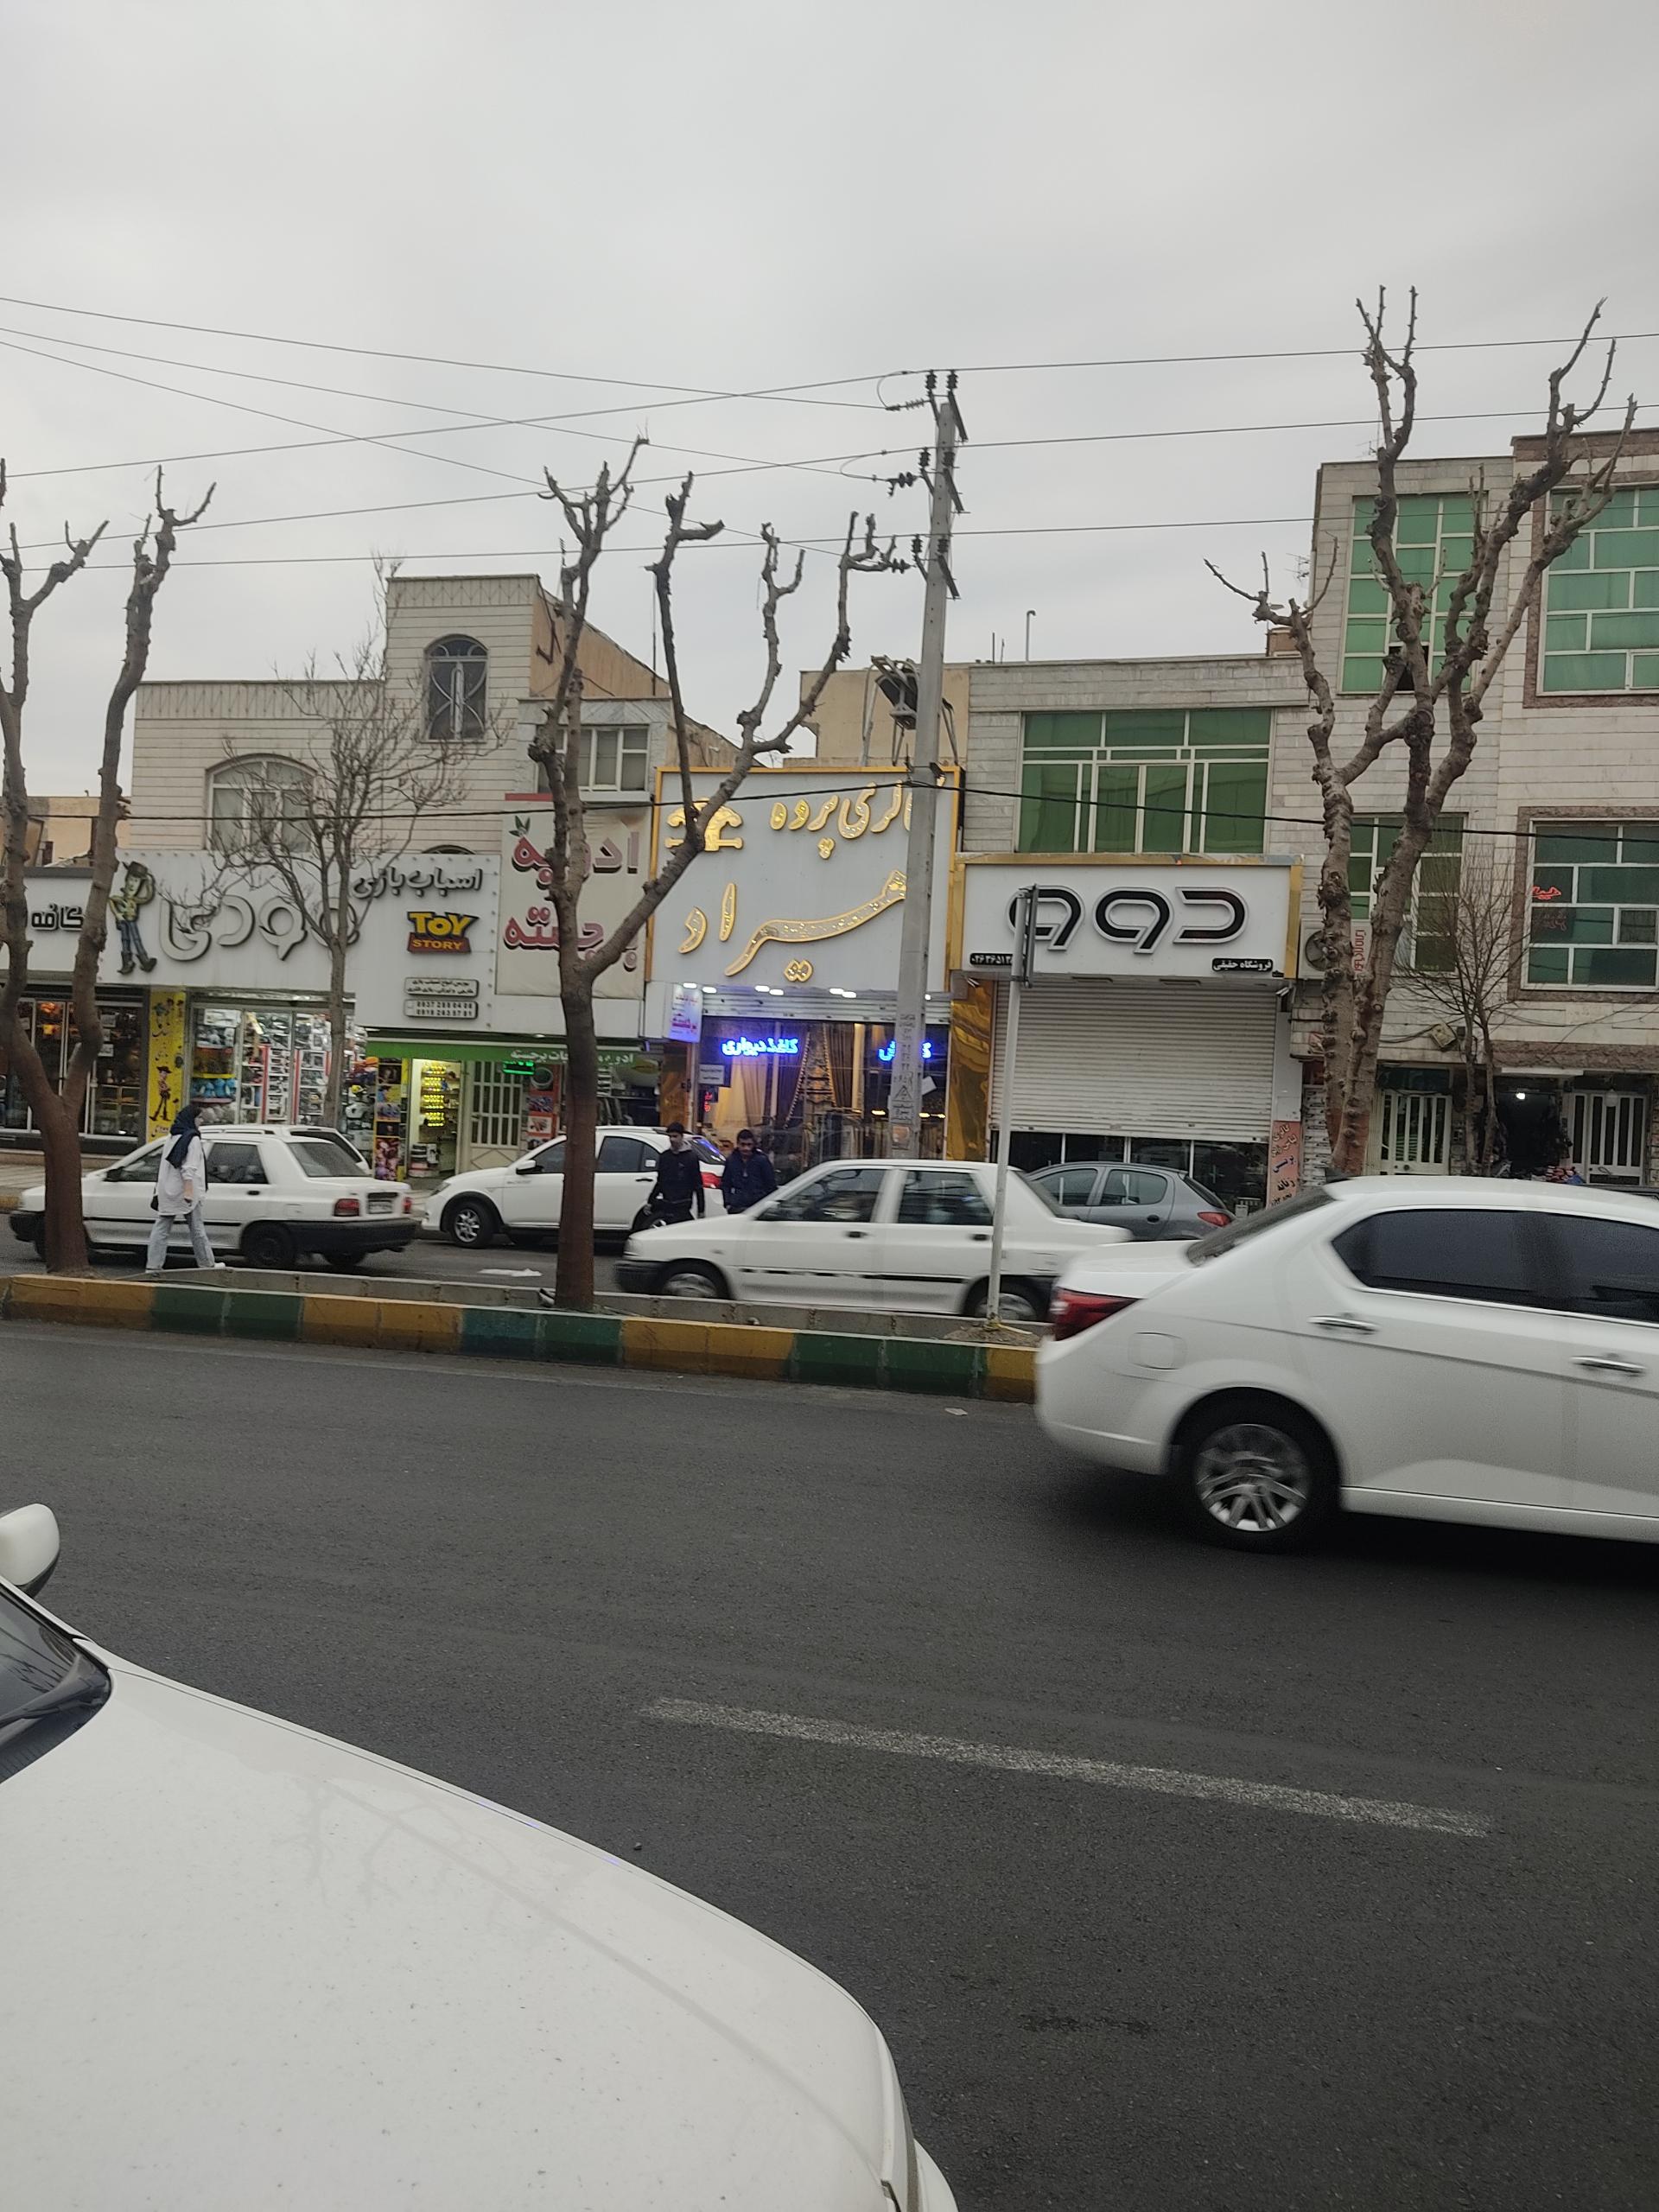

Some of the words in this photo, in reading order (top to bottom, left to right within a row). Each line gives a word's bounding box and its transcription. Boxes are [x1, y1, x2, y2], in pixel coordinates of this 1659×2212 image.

[769, 794, 841, 861] پرده
[351, 866, 406, 899] بازی
[406, 867, 483, 898] اسباب
[31, 903, 85, 931] کافه
[409, 912, 476, 937] TOY
[411, 938, 464, 950] STORY
[1213, 961, 1239, 970] حقیقی
[1239, 960, 1273, 971] فروشگاه
[721, 1037, 767, 1057] دیواری
[766, 1038, 799, 1054] کاغذ
